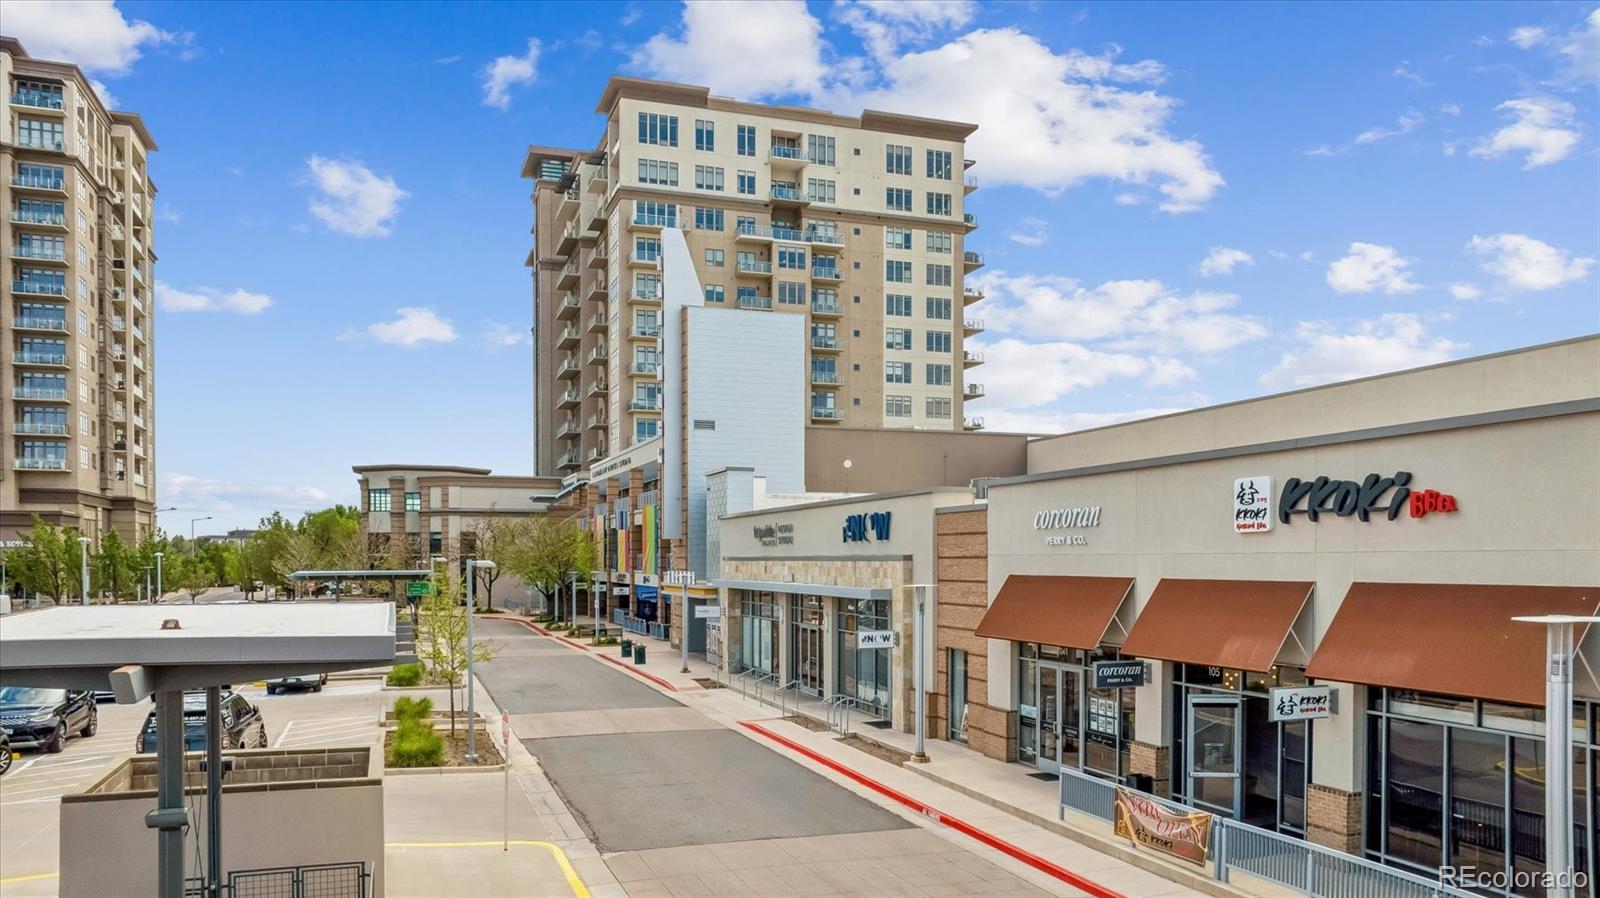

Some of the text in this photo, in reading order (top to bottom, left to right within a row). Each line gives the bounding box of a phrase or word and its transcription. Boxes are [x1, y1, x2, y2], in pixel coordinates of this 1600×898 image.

[1410, 489, 1458, 518] BBQ
[1034, 506, 1101, 529] corcoran
[1099, 666, 1141, 677] corcoran
[1208, 666, 1221, 677] 105
